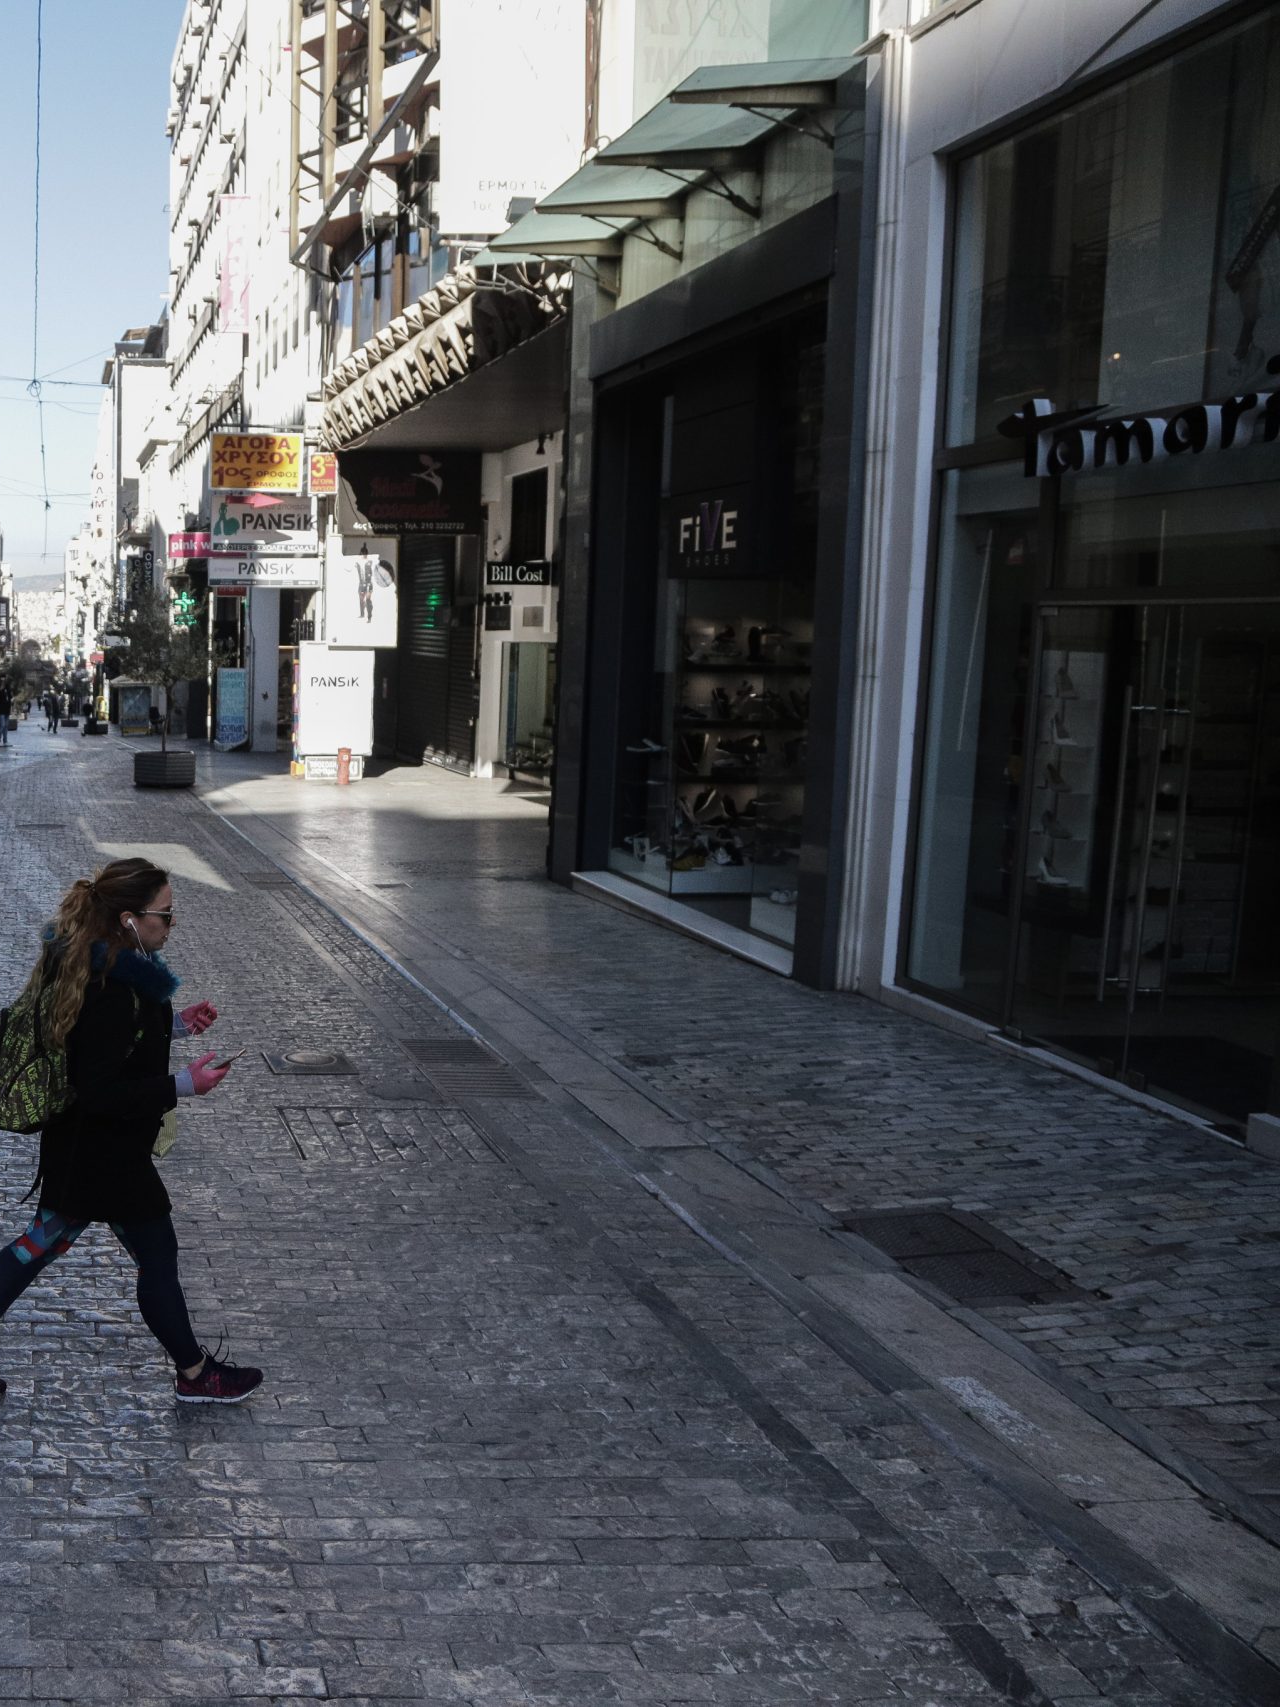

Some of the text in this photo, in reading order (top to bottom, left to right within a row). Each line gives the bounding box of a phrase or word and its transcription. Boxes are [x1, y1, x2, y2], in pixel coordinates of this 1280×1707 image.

[478, 180, 525, 191] ΕΡΜΟΥ
[222, 436, 290, 449] ΑΓΟΡΑ
[214, 451, 296, 464] ΧΡΥΣΟΥ
[256, 470, 297, 478] ΟΡΟΦΟΣ
[171, 539, 198, 552] pink
[491, 565, 543, 582] Bill Cost
